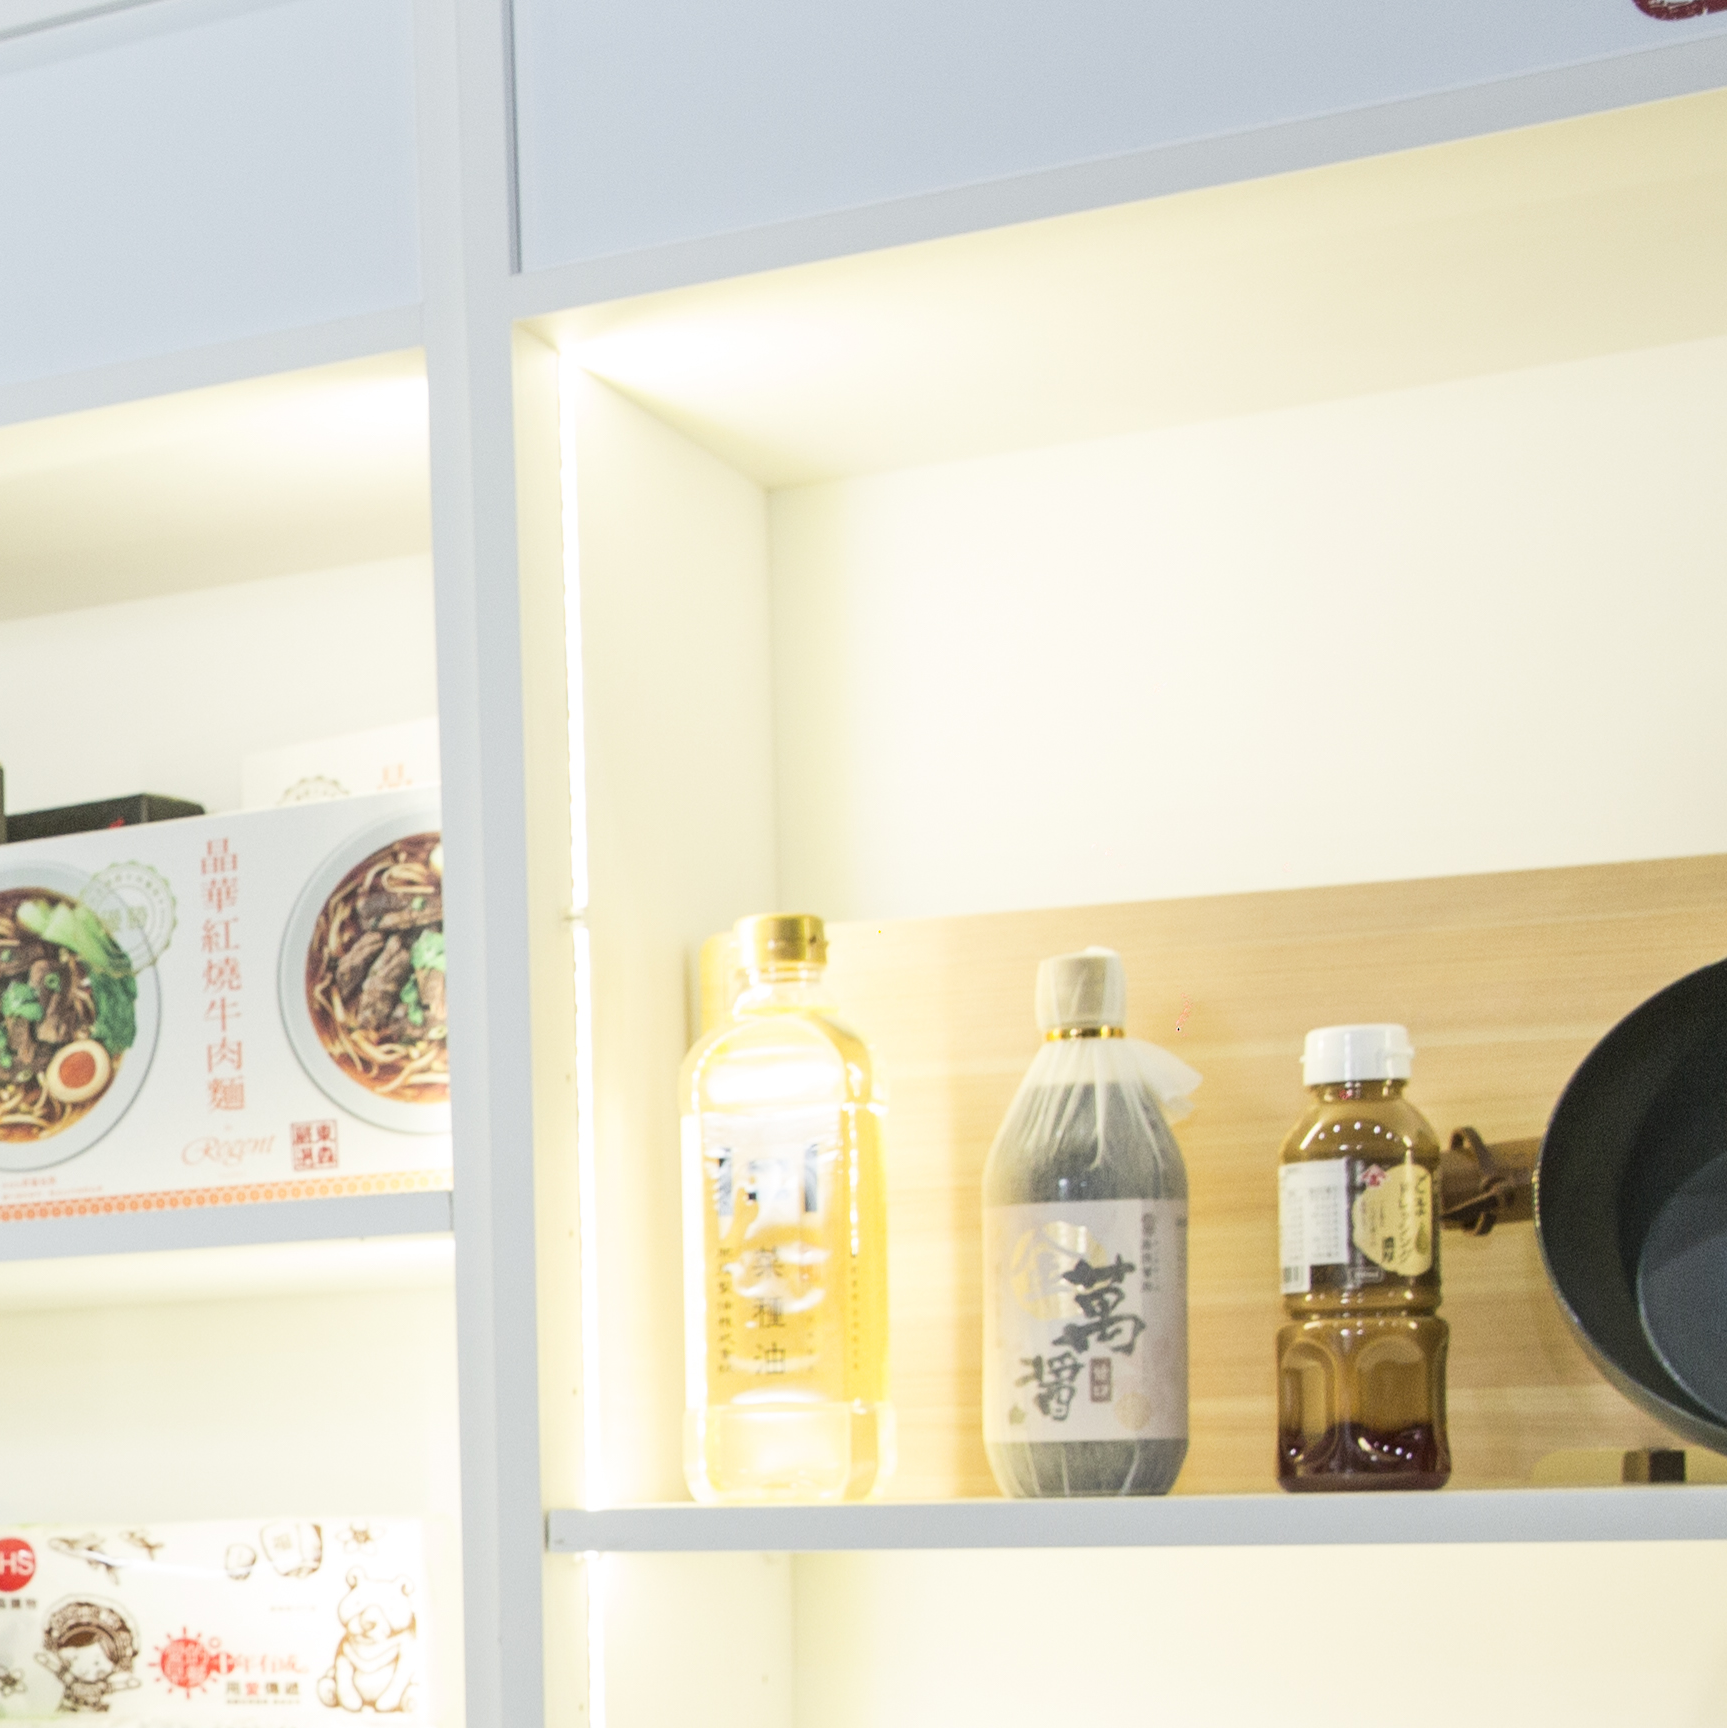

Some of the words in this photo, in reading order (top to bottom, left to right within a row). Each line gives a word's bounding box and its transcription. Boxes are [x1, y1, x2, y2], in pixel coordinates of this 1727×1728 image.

[200, 838, 245, 1111] 晶華紅燒牛肉麵
[181, 1134, 275, 1167] Regent
[752, 1247, 786, 1376] 菜種油
